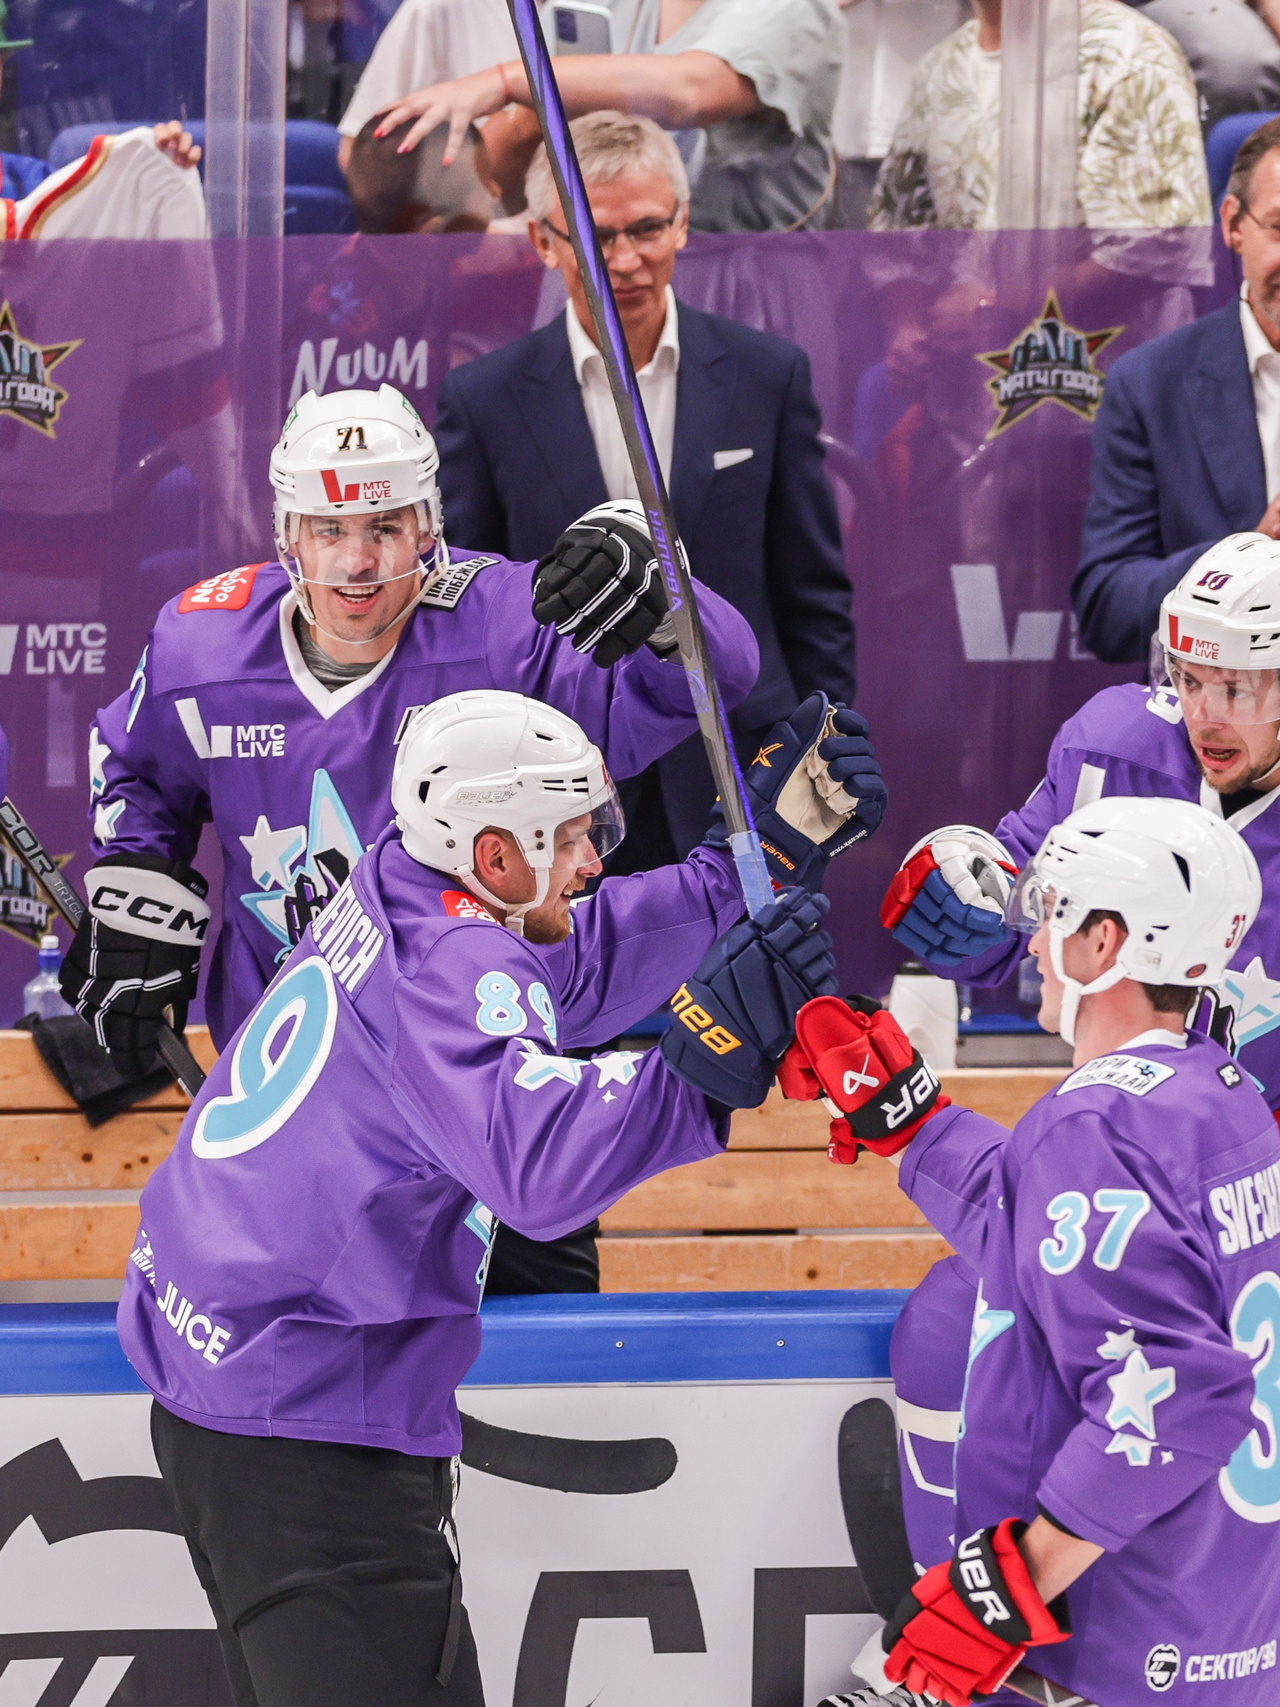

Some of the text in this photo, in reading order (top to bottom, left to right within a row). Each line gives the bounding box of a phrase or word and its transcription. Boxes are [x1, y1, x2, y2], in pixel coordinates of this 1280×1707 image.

[336, 426, 368, 452] 71
[364, 489, 391, 500] LIVE
[648, 509, 684, 594] BAUER
[1197, 571, 1233, 591] 10
[26, 649, 106, 675] LIVE
[1194, 649, 1219, 661] LIVE
[236, 740, 286, 758] LIVE
[759, 840, 796, 871] BAUER
[91, 885, 210, 941] CCM
[192, 955, 338, 1160] 9
[1039, 1189, 1151, 1275] 37
[156, 1280, 232, 1366] JUICE
